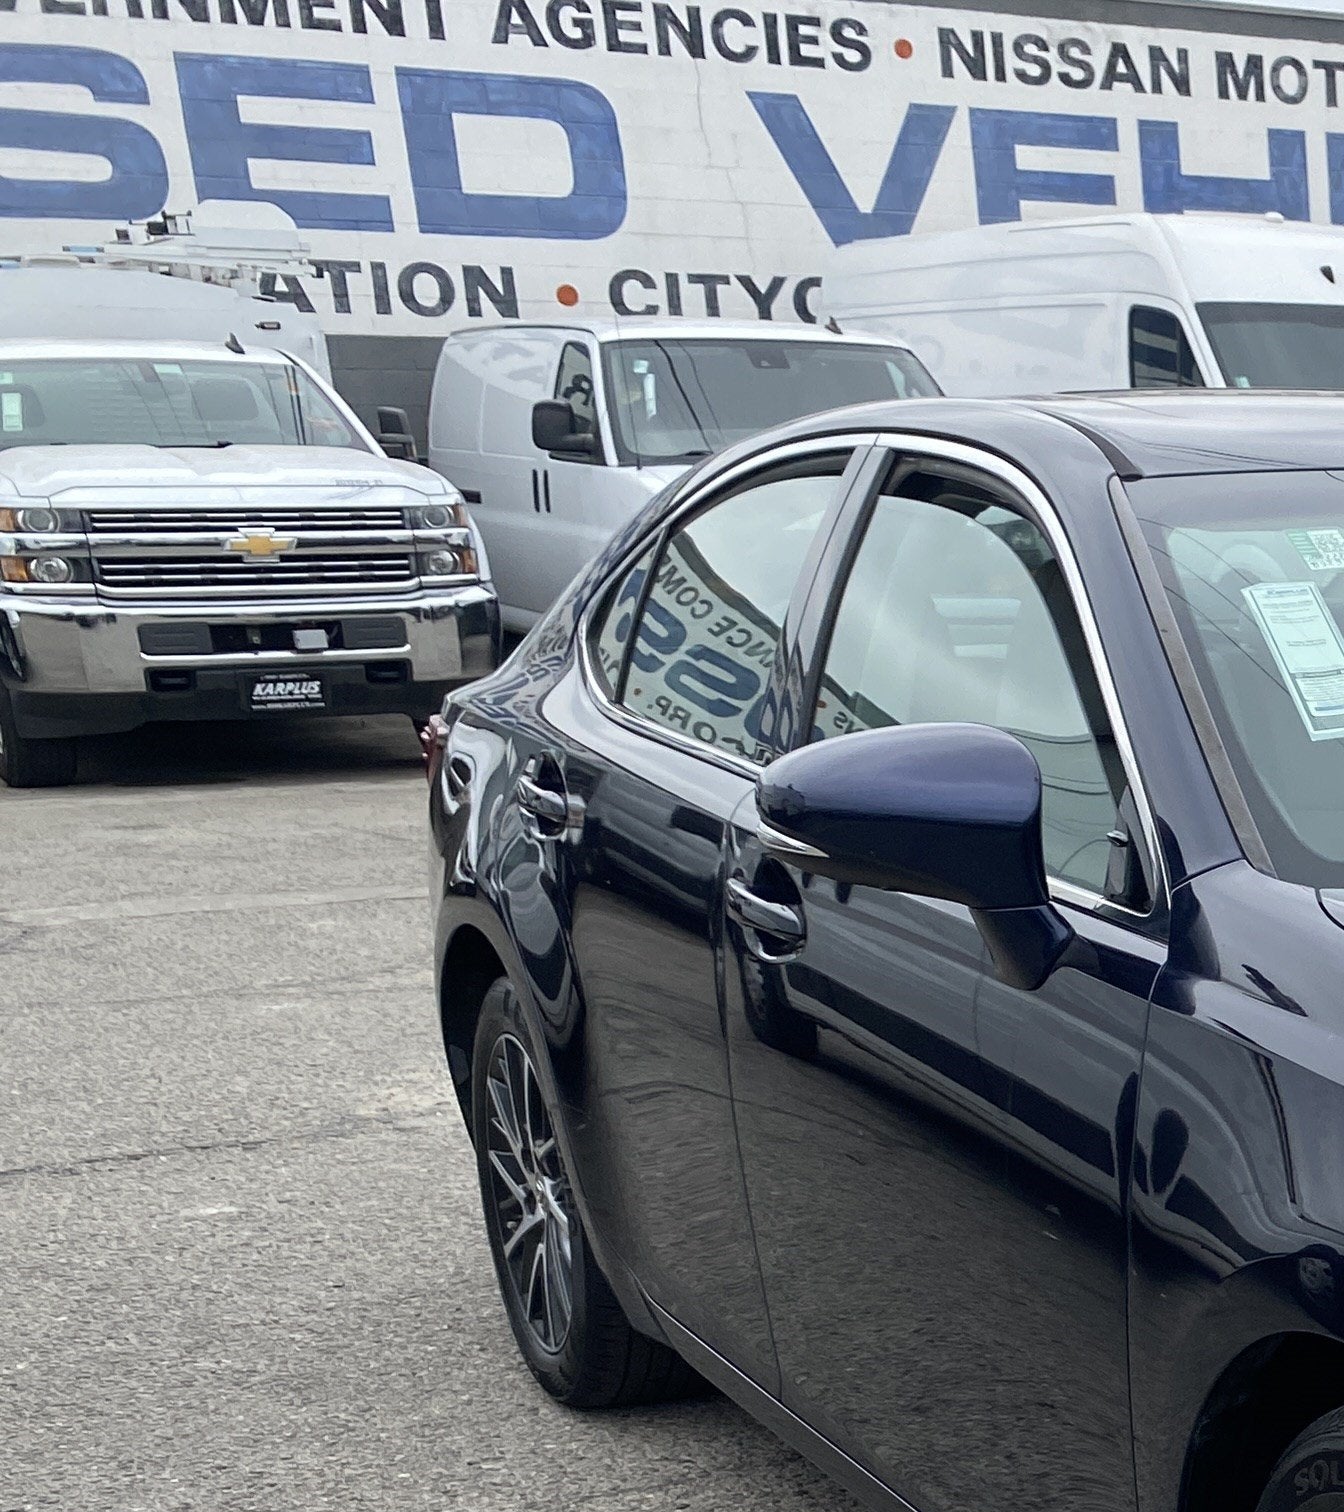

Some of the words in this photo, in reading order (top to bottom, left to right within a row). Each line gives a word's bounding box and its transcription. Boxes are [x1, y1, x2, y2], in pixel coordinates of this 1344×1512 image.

[491, 0, 873, 72] AGENCIES
[937, 27, 1191, 97] NISSAN
[253, 681, 320, 695] KARPLUS
